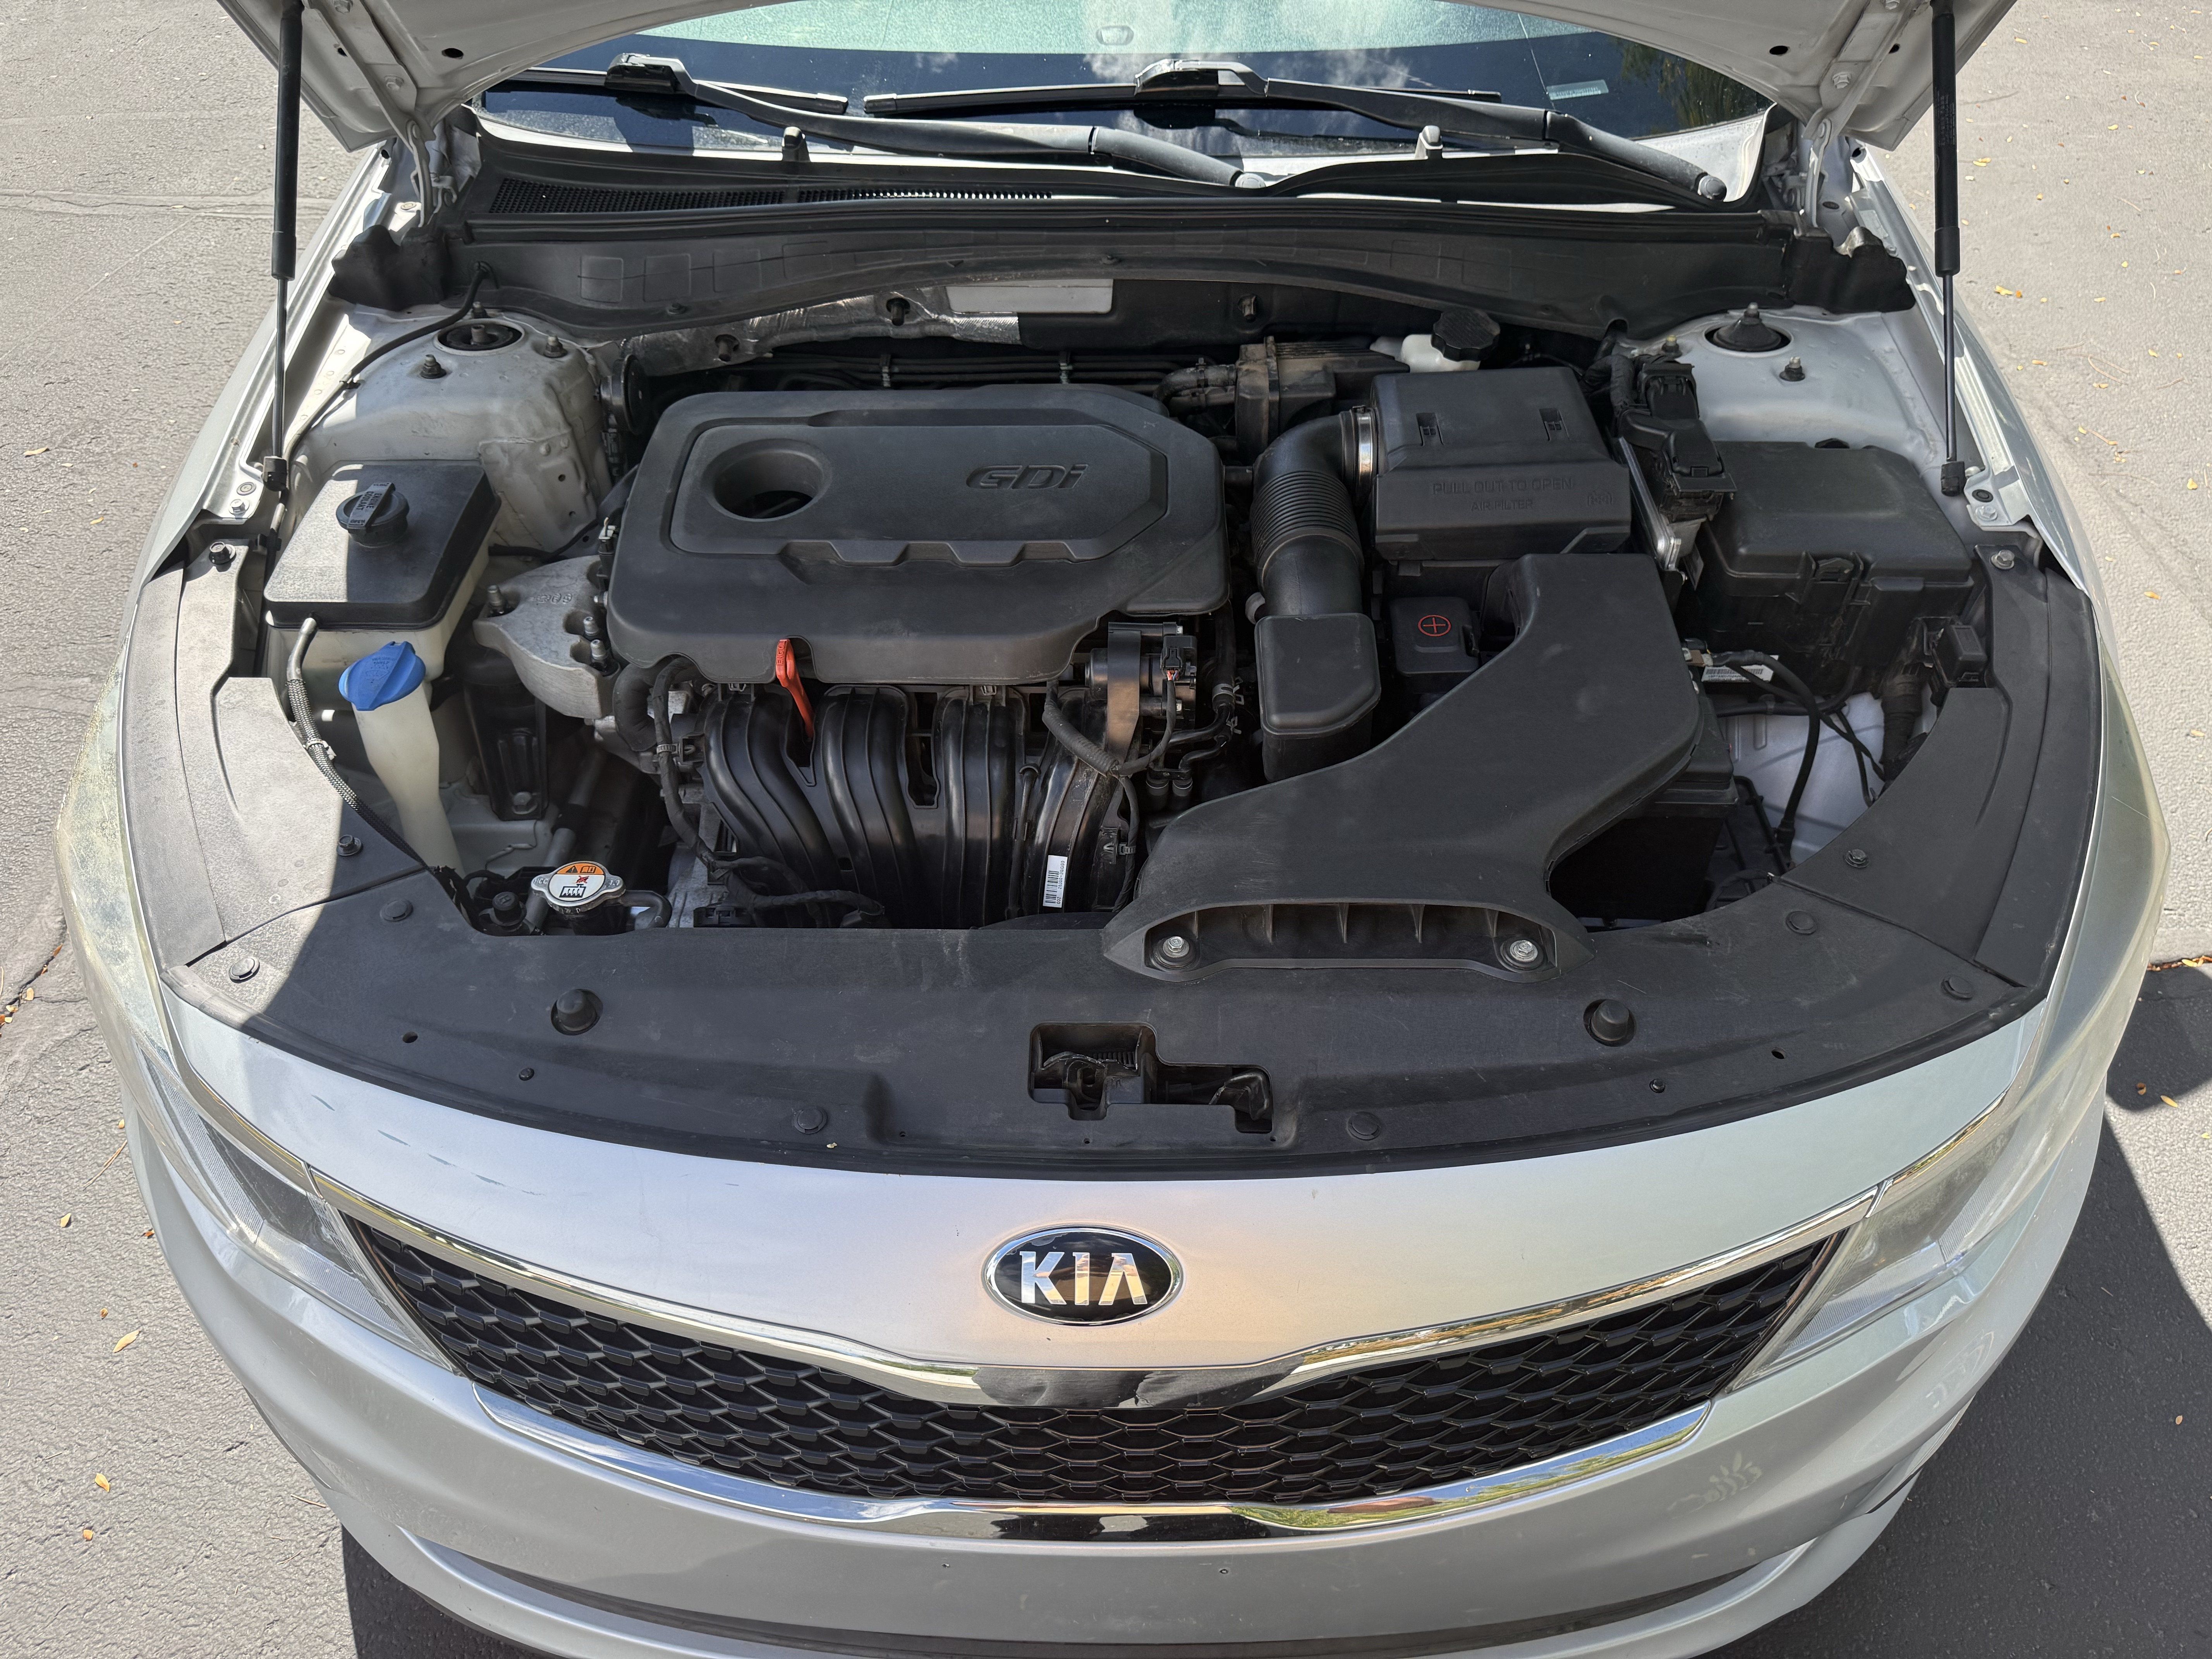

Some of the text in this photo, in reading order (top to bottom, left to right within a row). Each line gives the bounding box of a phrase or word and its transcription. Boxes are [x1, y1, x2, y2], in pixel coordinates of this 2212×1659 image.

[966, 464, 1089, 490] GDi
[1432, 476, 1573, 495] PULL OUT TO OPEN
[356, 491, 374, 511] COOLANT
[366, 493, 382, 508] ENGINE
[1471, 498, 1534, 512] AIR FILTER
[1019, 1251, 1147, 1305] KIA
